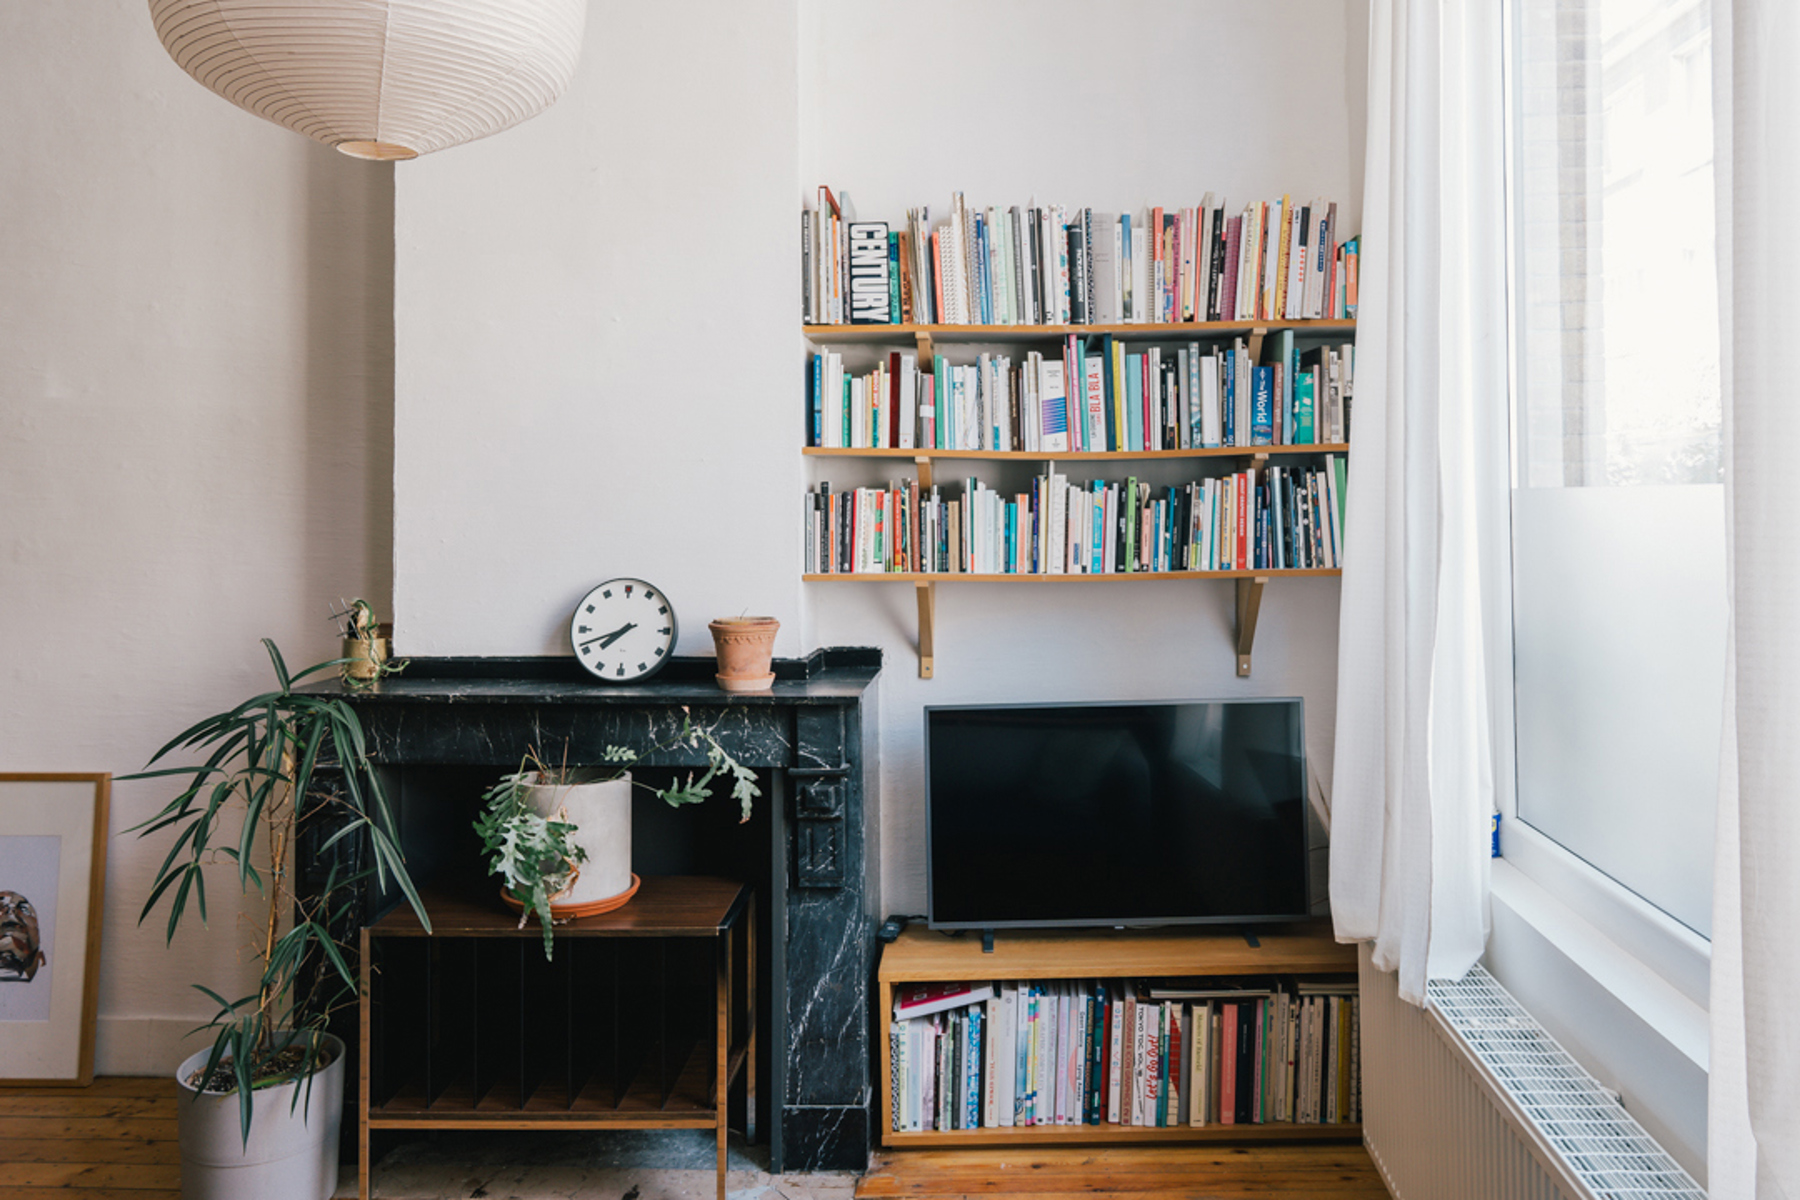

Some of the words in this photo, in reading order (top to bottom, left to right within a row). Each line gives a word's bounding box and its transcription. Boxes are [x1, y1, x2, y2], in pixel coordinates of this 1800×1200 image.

[850, 223, 889, 322] CENTURY
[1088, 372, 1100, 390] BLA
[1090, 394, 1101, 412] BLA
[1256, 390, 1268, 422] World
[1126, 1001, 1134, 1044] PICTOGRAM
[1146, 1034, 1158, 1058] Out!
[1147, 1060, 1158, 1073] Go
[1146, 1074, 1157, 1100] Let's
